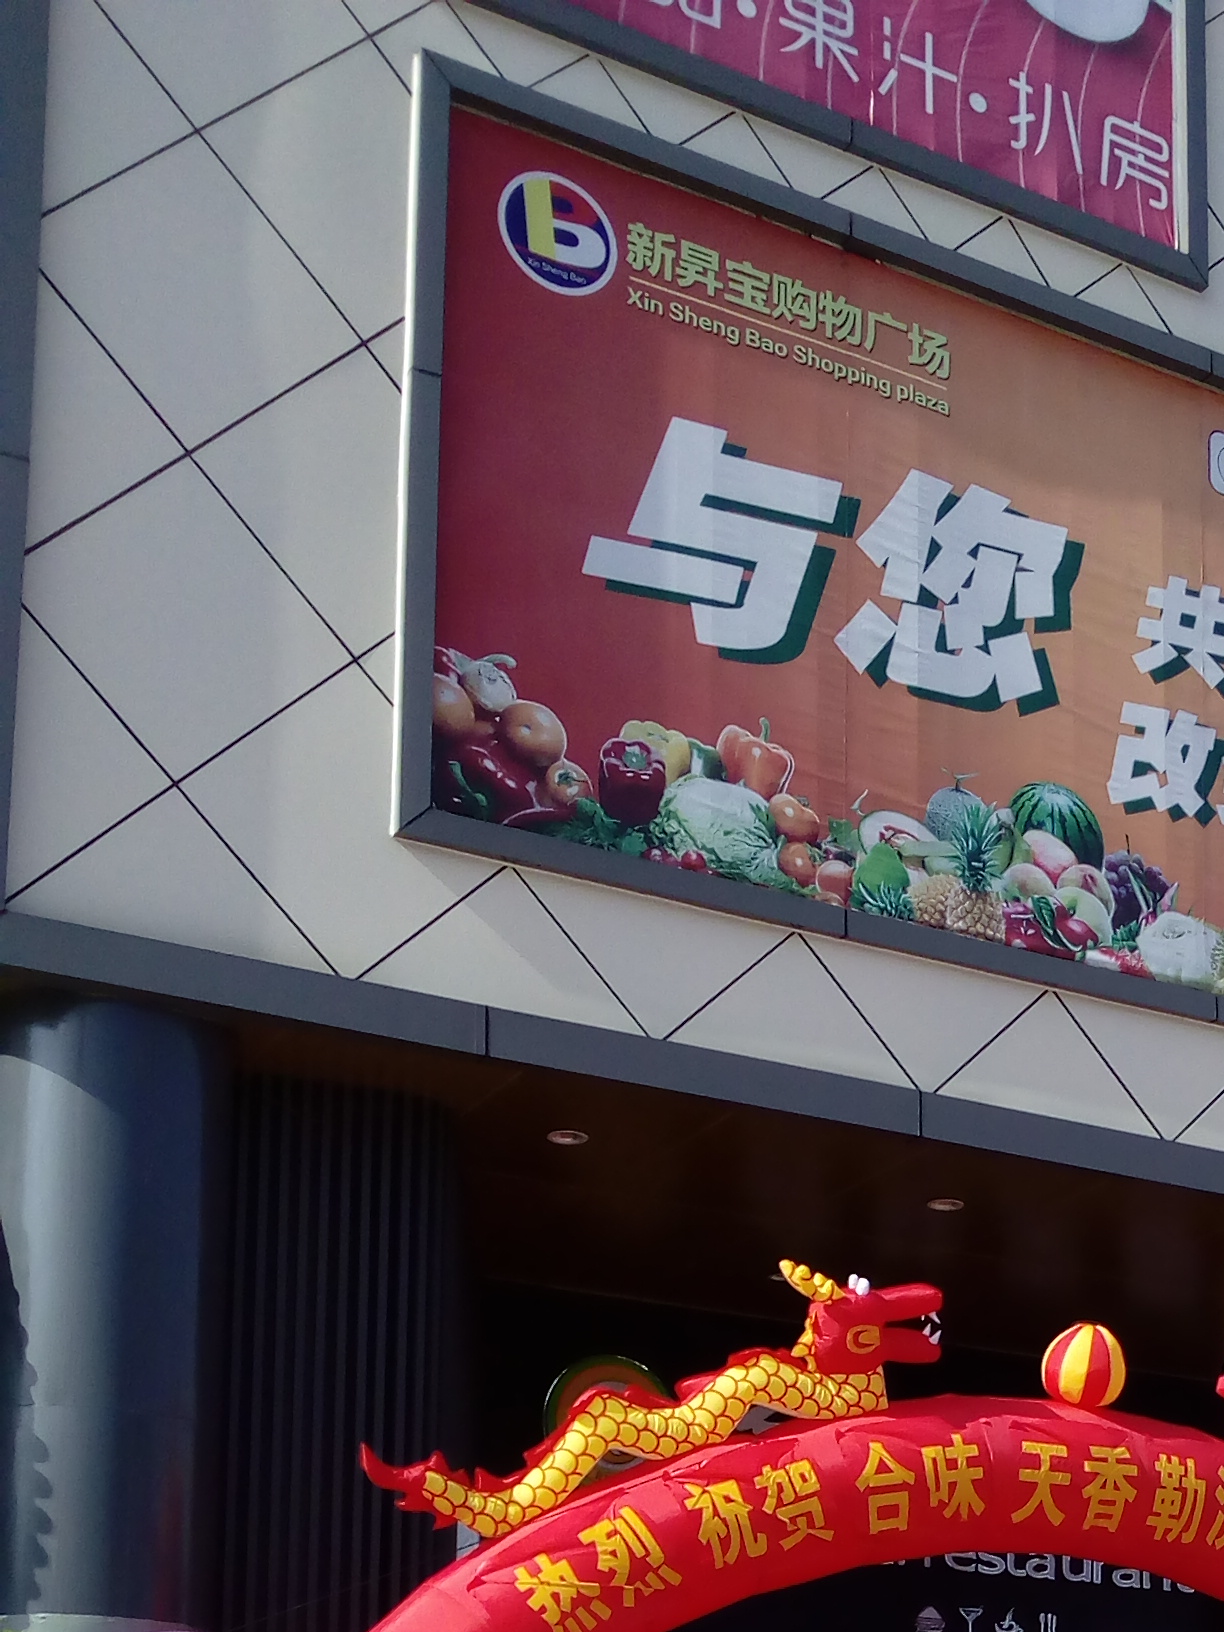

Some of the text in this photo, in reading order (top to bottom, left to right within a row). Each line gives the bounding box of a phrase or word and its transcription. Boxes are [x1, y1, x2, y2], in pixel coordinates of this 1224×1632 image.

[625, 222, 951, 380] 新昇宝购物广场
[626, 286, 950, 416] Xin Sheng Bao Shopping plaza
[582, 416, 1070, 702] 与您
